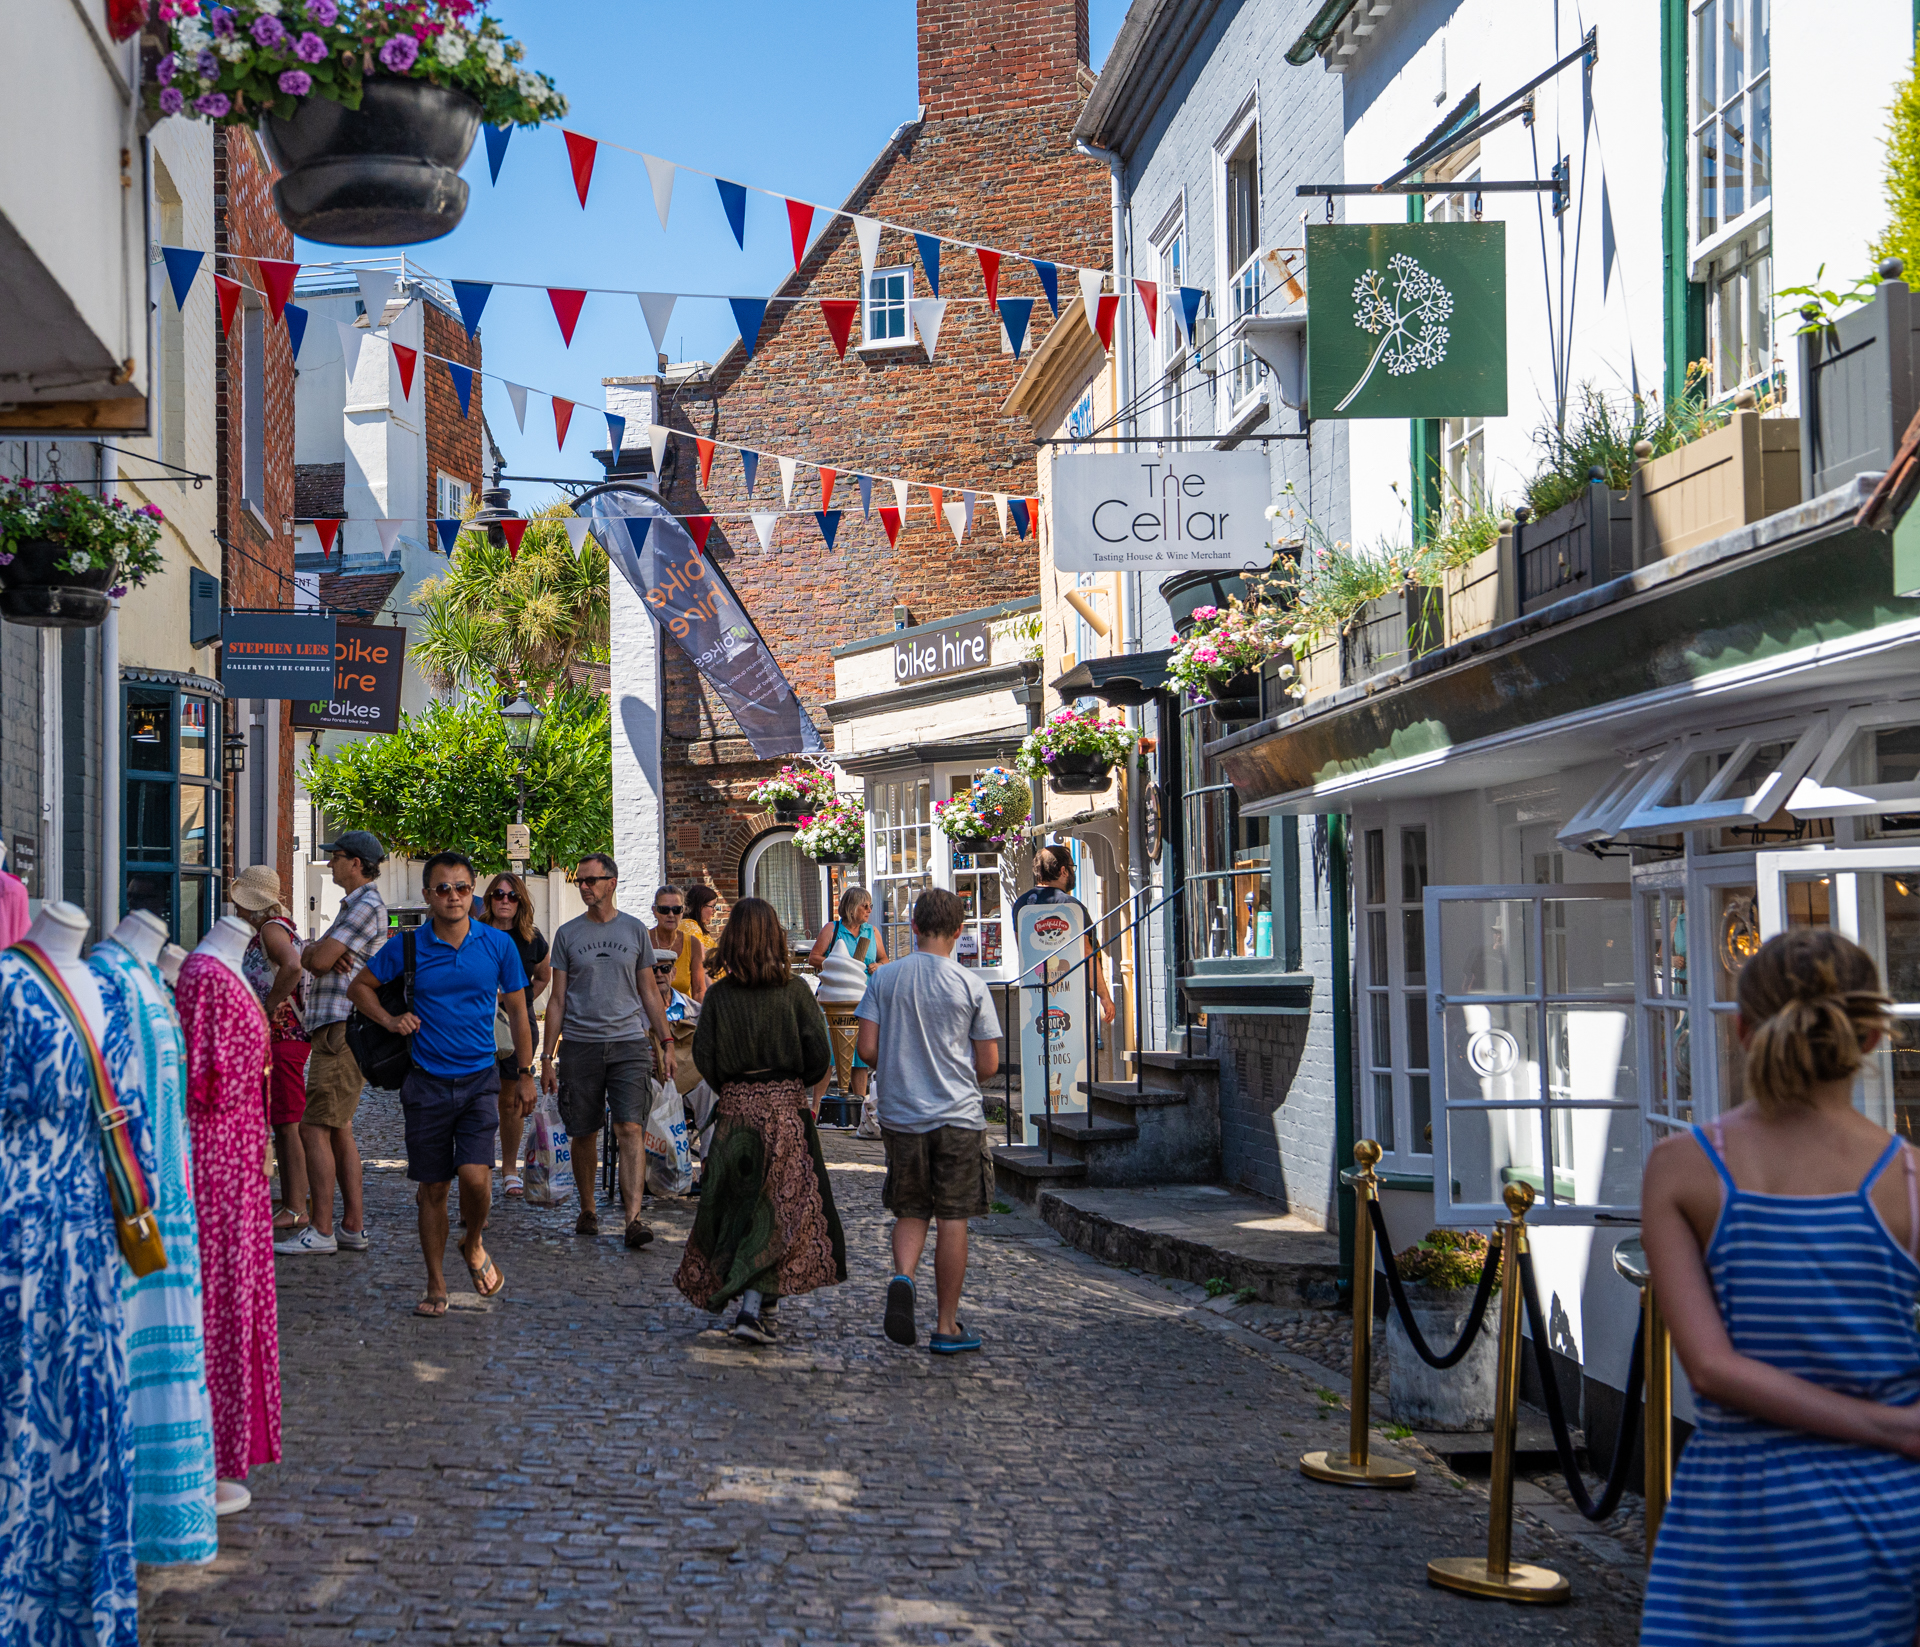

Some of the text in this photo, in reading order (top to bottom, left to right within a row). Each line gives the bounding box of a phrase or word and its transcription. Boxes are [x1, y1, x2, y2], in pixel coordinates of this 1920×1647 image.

[1141, 463, 1205, 498] The
[1092, 498, 1230, 543] Cellar
[1093, 550, 1232, 563] Tasting House & Wine Merchant
[229, 642, 329, 656] STEPHEN LEES
[896, 631, 985, 679] bike hire
[1053, 1052, 1071, 1065] DOGS
